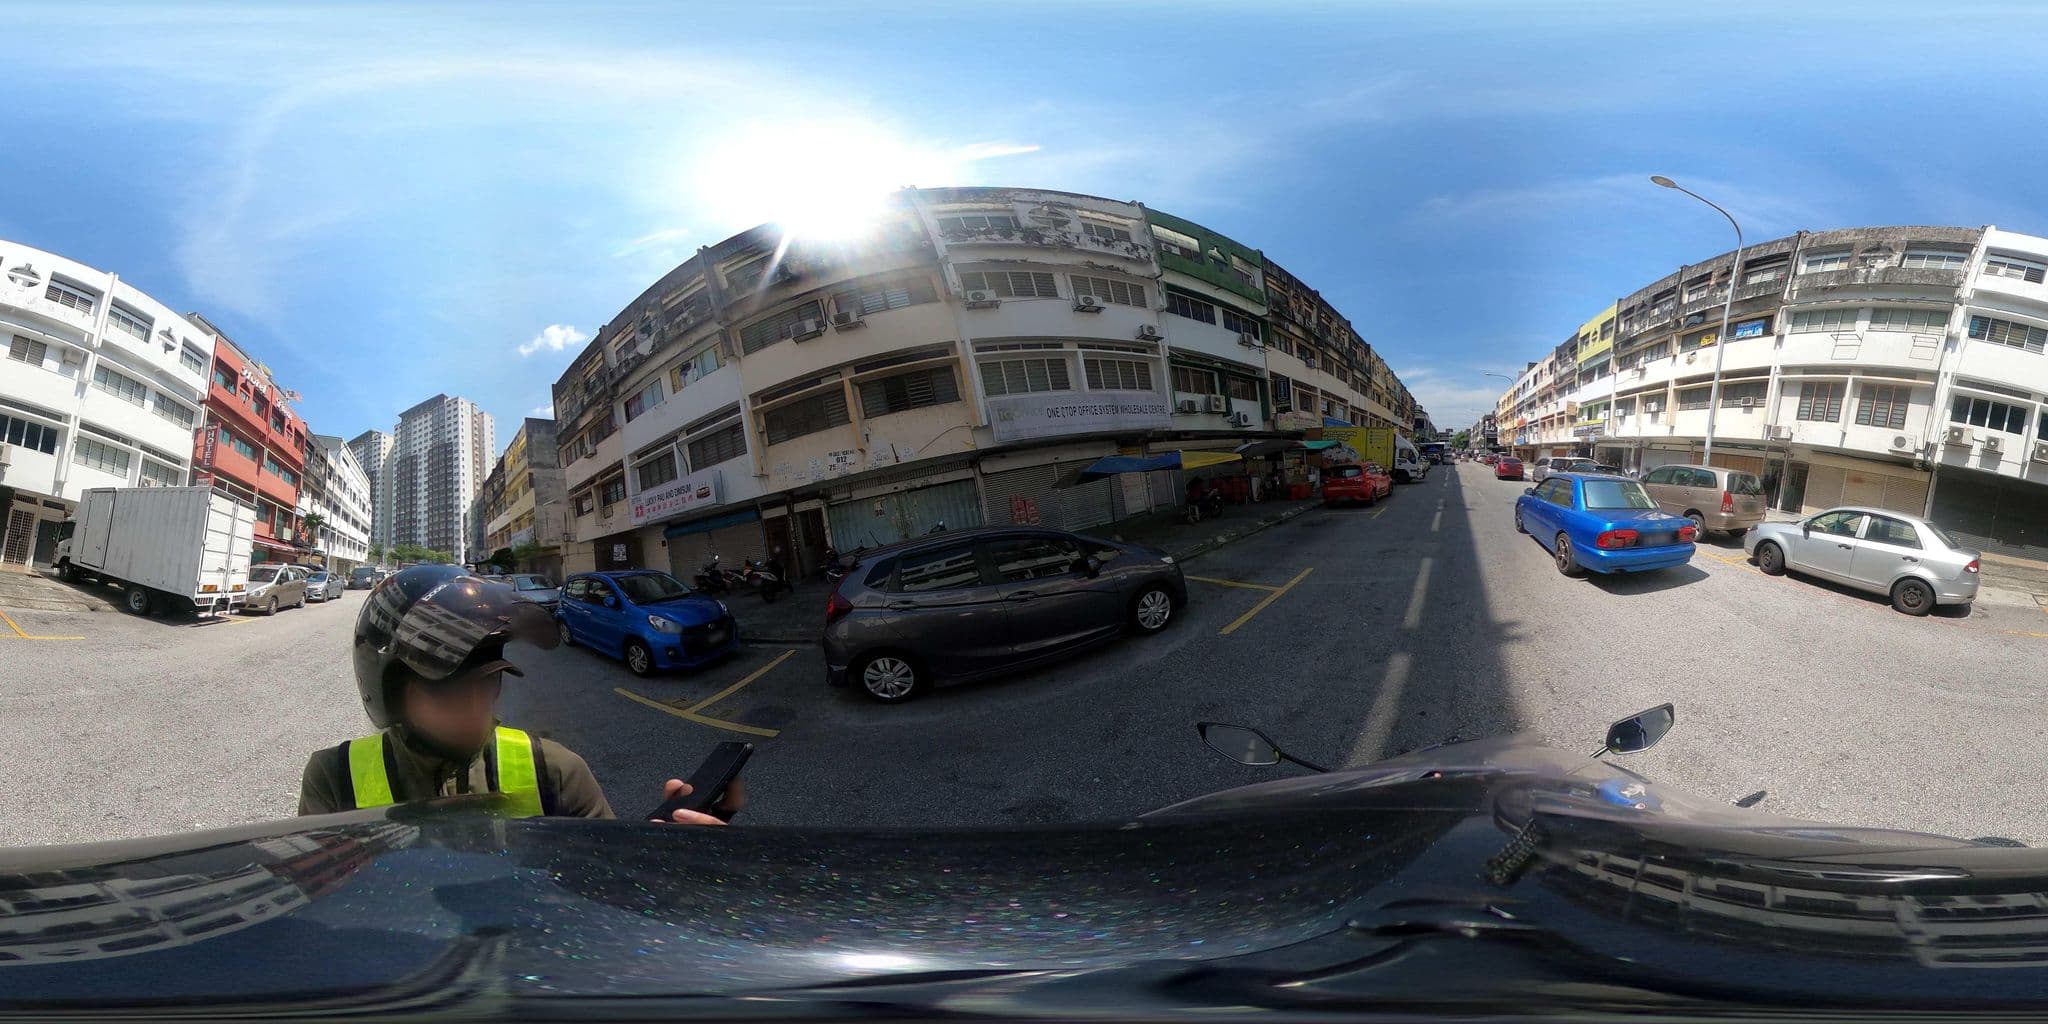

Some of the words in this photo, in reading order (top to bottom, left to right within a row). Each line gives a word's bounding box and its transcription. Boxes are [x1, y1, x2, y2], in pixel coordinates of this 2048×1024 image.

[1046, 406, 1060, 418] ONE
[1077, 404, 1098, 415] OFFICE
[1098, 404, 1119, 415] SYSTEM
[1119, 403, 1148, 415] WHOLESALE
[1148, 403, 1167, 414] CENTRE
[204, 431, 215, 466] HOTEL
